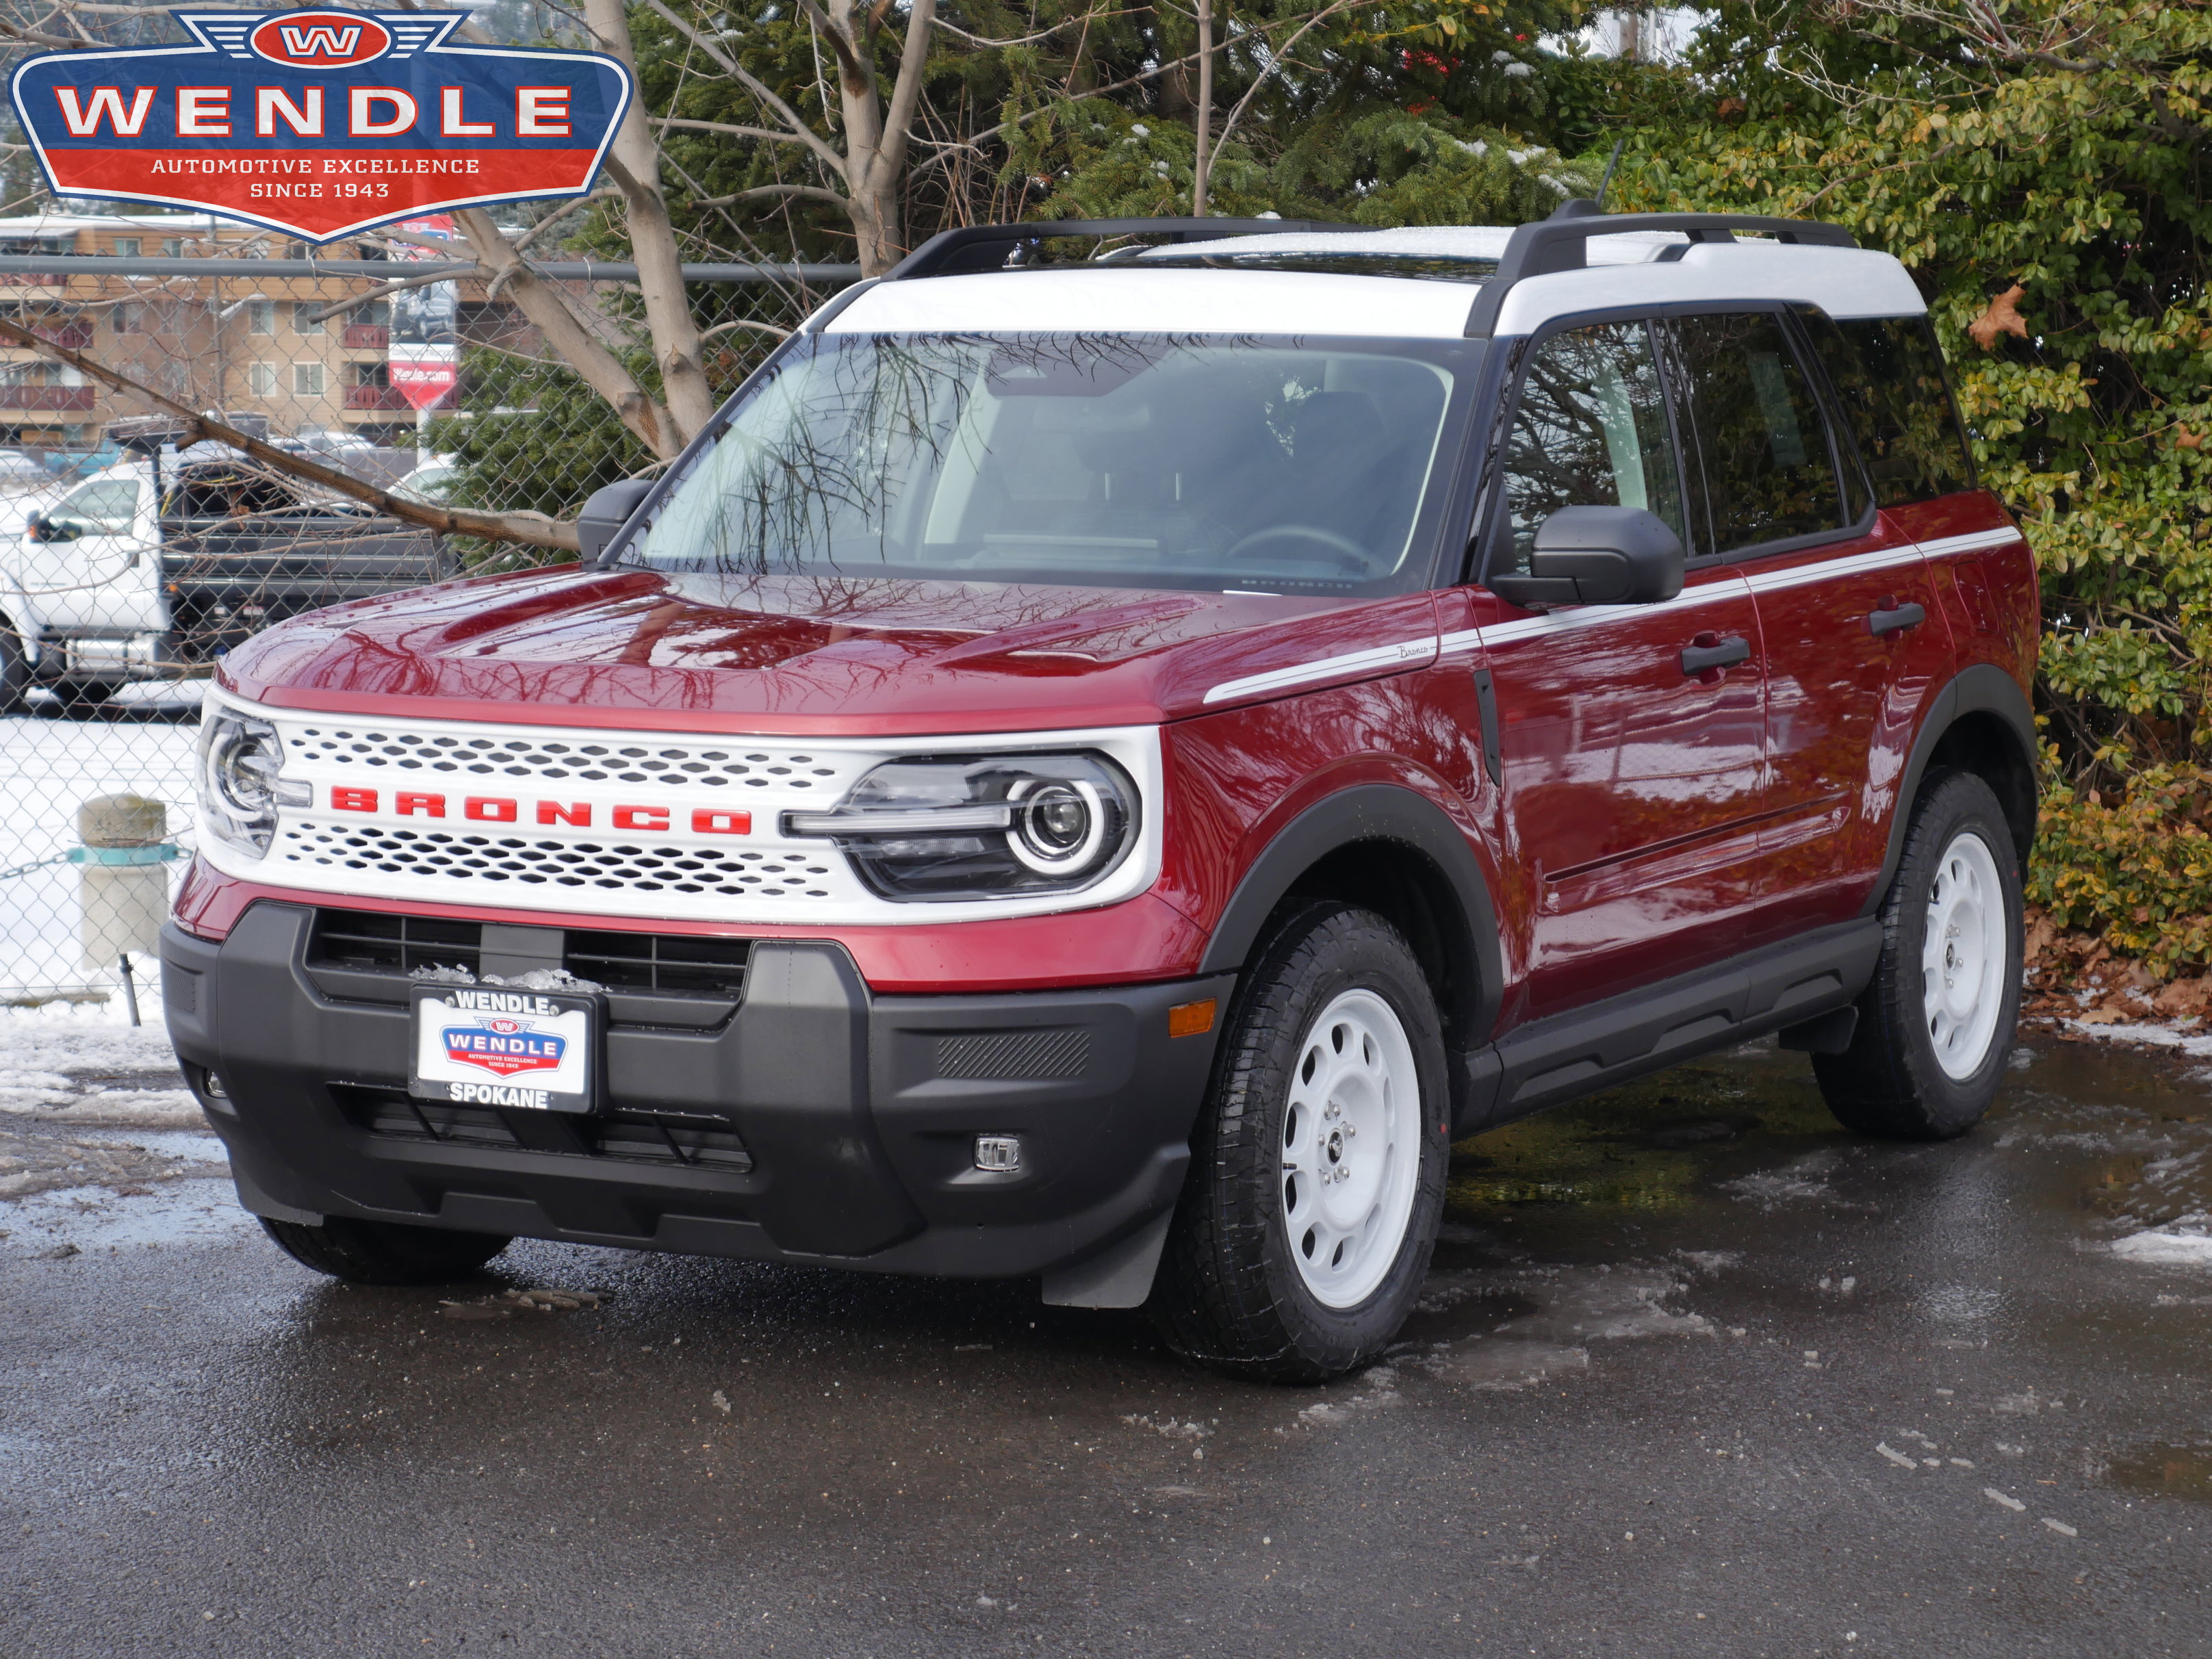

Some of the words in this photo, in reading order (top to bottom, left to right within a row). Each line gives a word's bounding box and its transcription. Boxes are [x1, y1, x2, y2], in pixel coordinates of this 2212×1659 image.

[1397, 645, 1428, 658] Bronco
[330, 785, 752, 836] BRONCO
[455, 990, 550, 1016] WENDLE
[448, 1033, 556, 1056] WENDLE
[468, 1053, 502, 1062] AUTOMOTIVE
[504, 1056, 537, 1064] EXCELLENCE
[449, 1082, 548, 1109] SPOKANE
